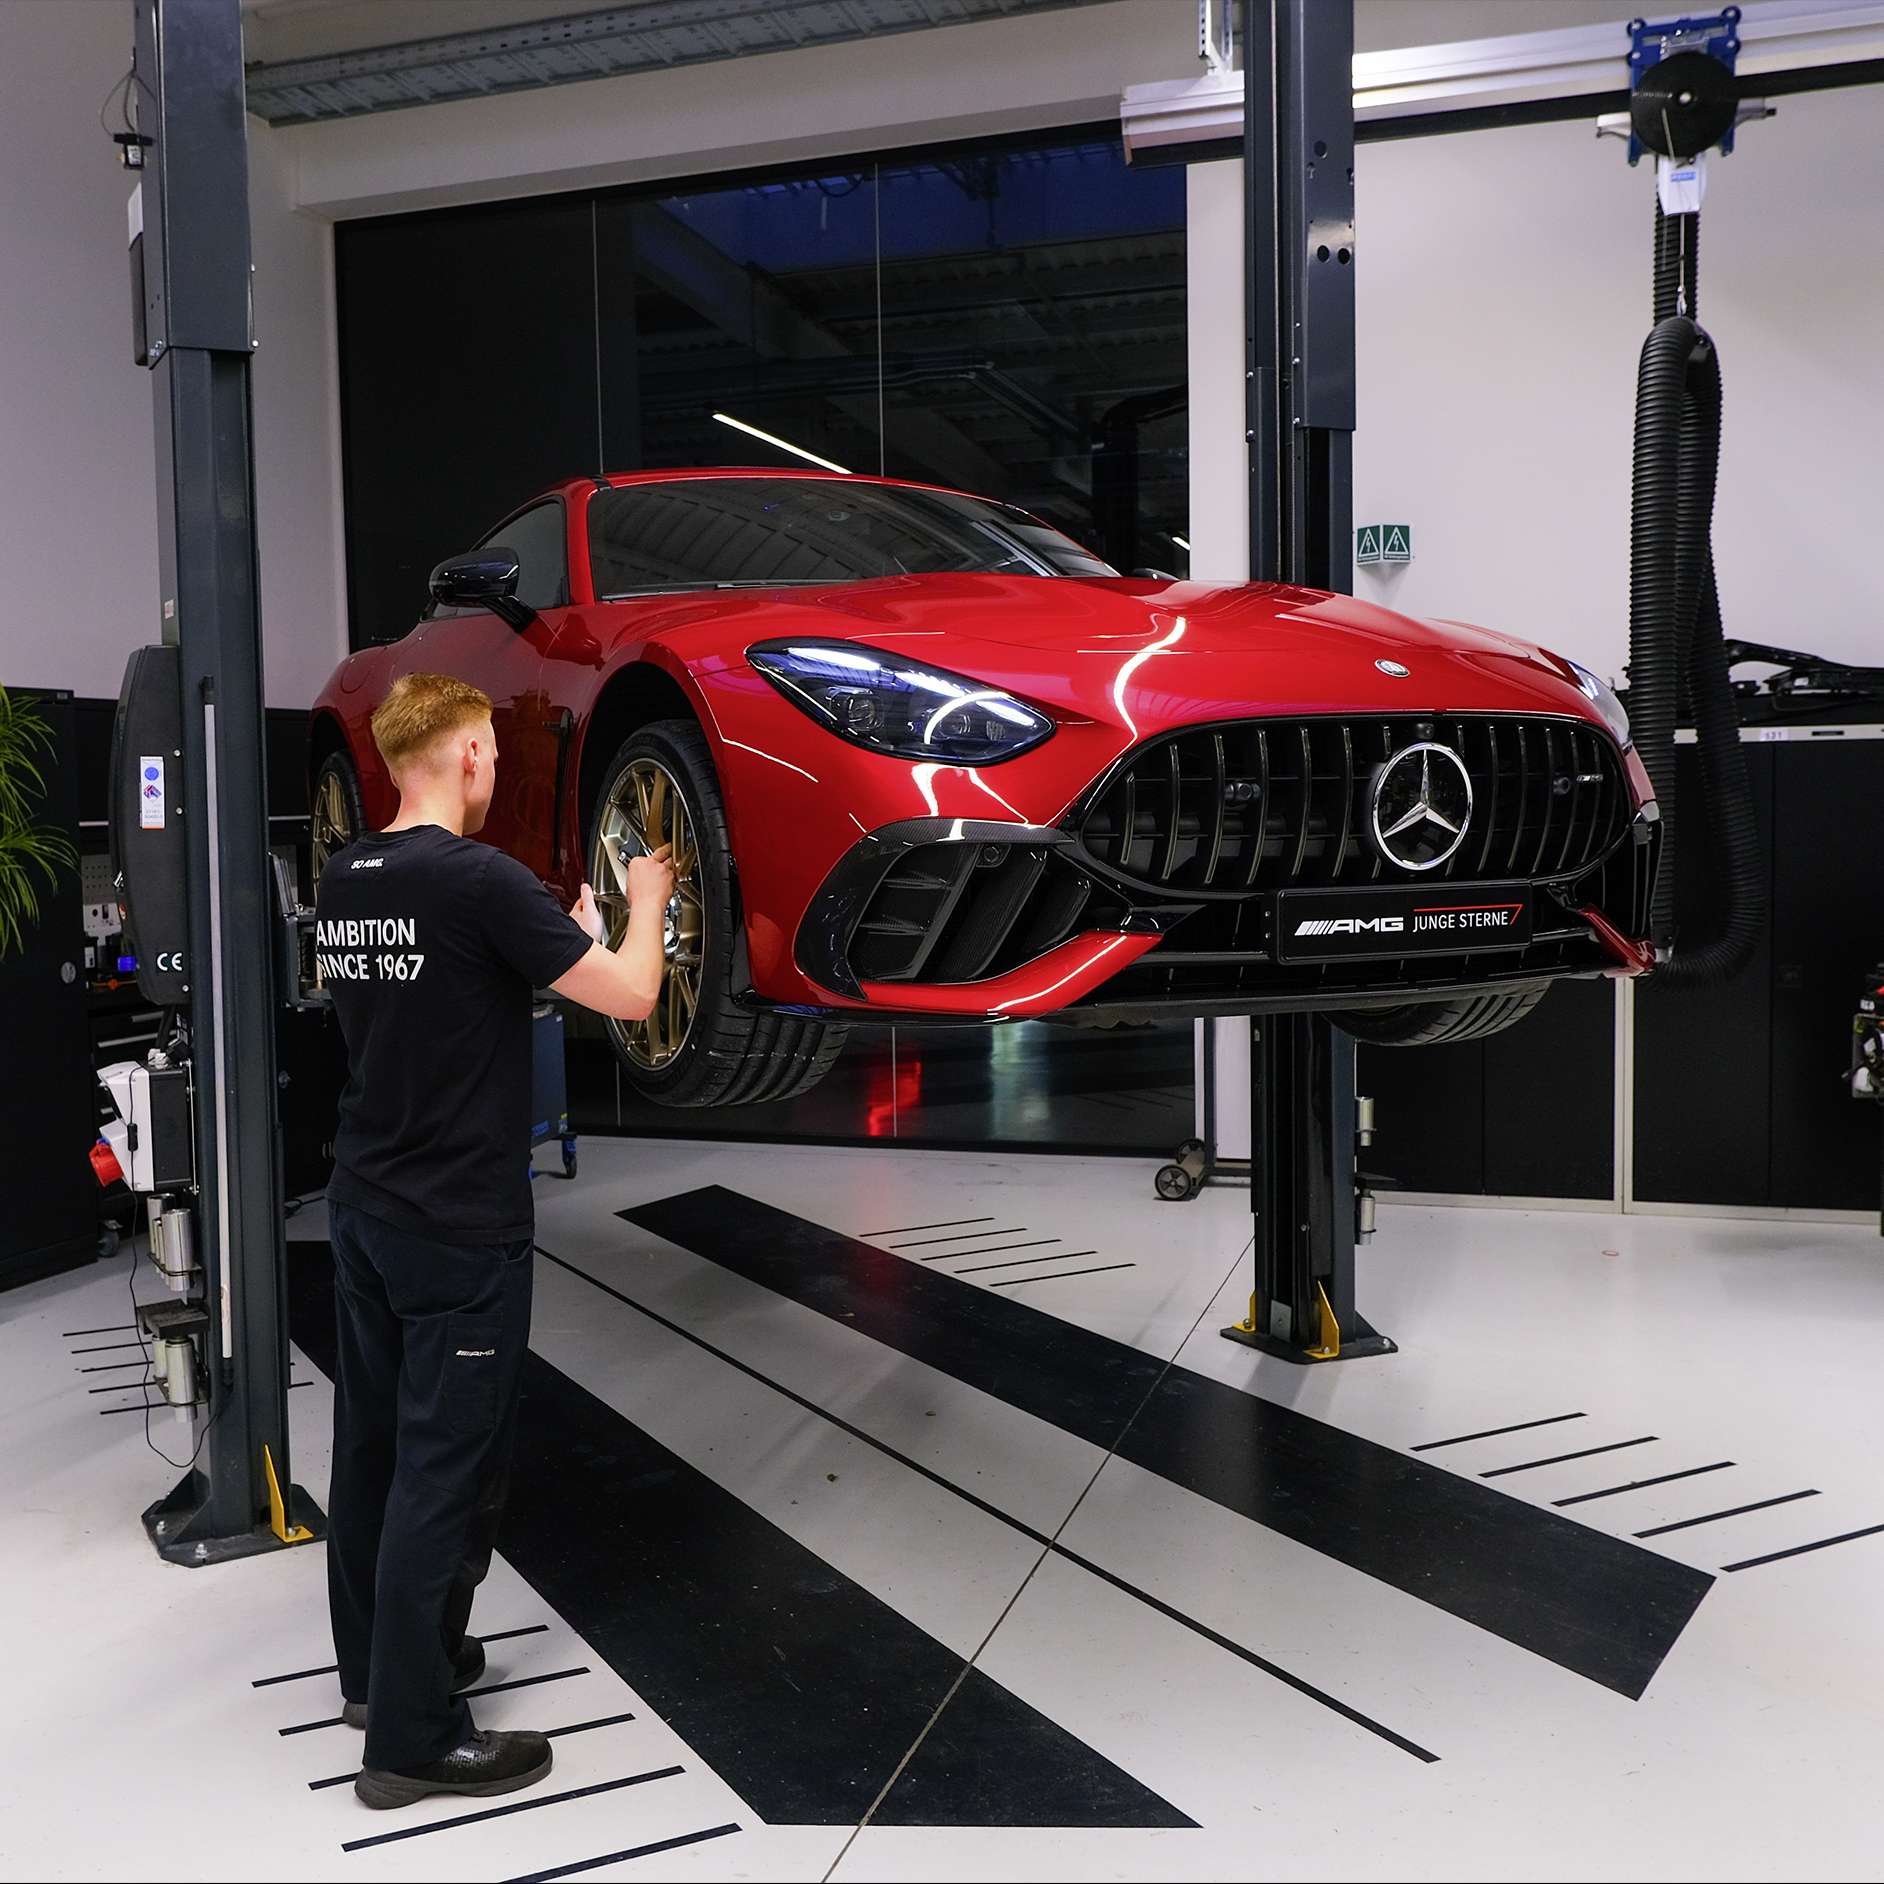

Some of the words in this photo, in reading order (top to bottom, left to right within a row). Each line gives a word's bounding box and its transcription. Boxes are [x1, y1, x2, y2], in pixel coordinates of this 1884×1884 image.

[351, 860, 363, 870] SO
[316, 918, 416, 947] AMBITION
[1328, 917, 1404, 934] AMG
[1412, 914, 1456, 933] JUNGE
[1459, 911, 1509, 928] STERNE
[156, 952, 183, 971] CE
[375, 953, 425, 981] 1967
